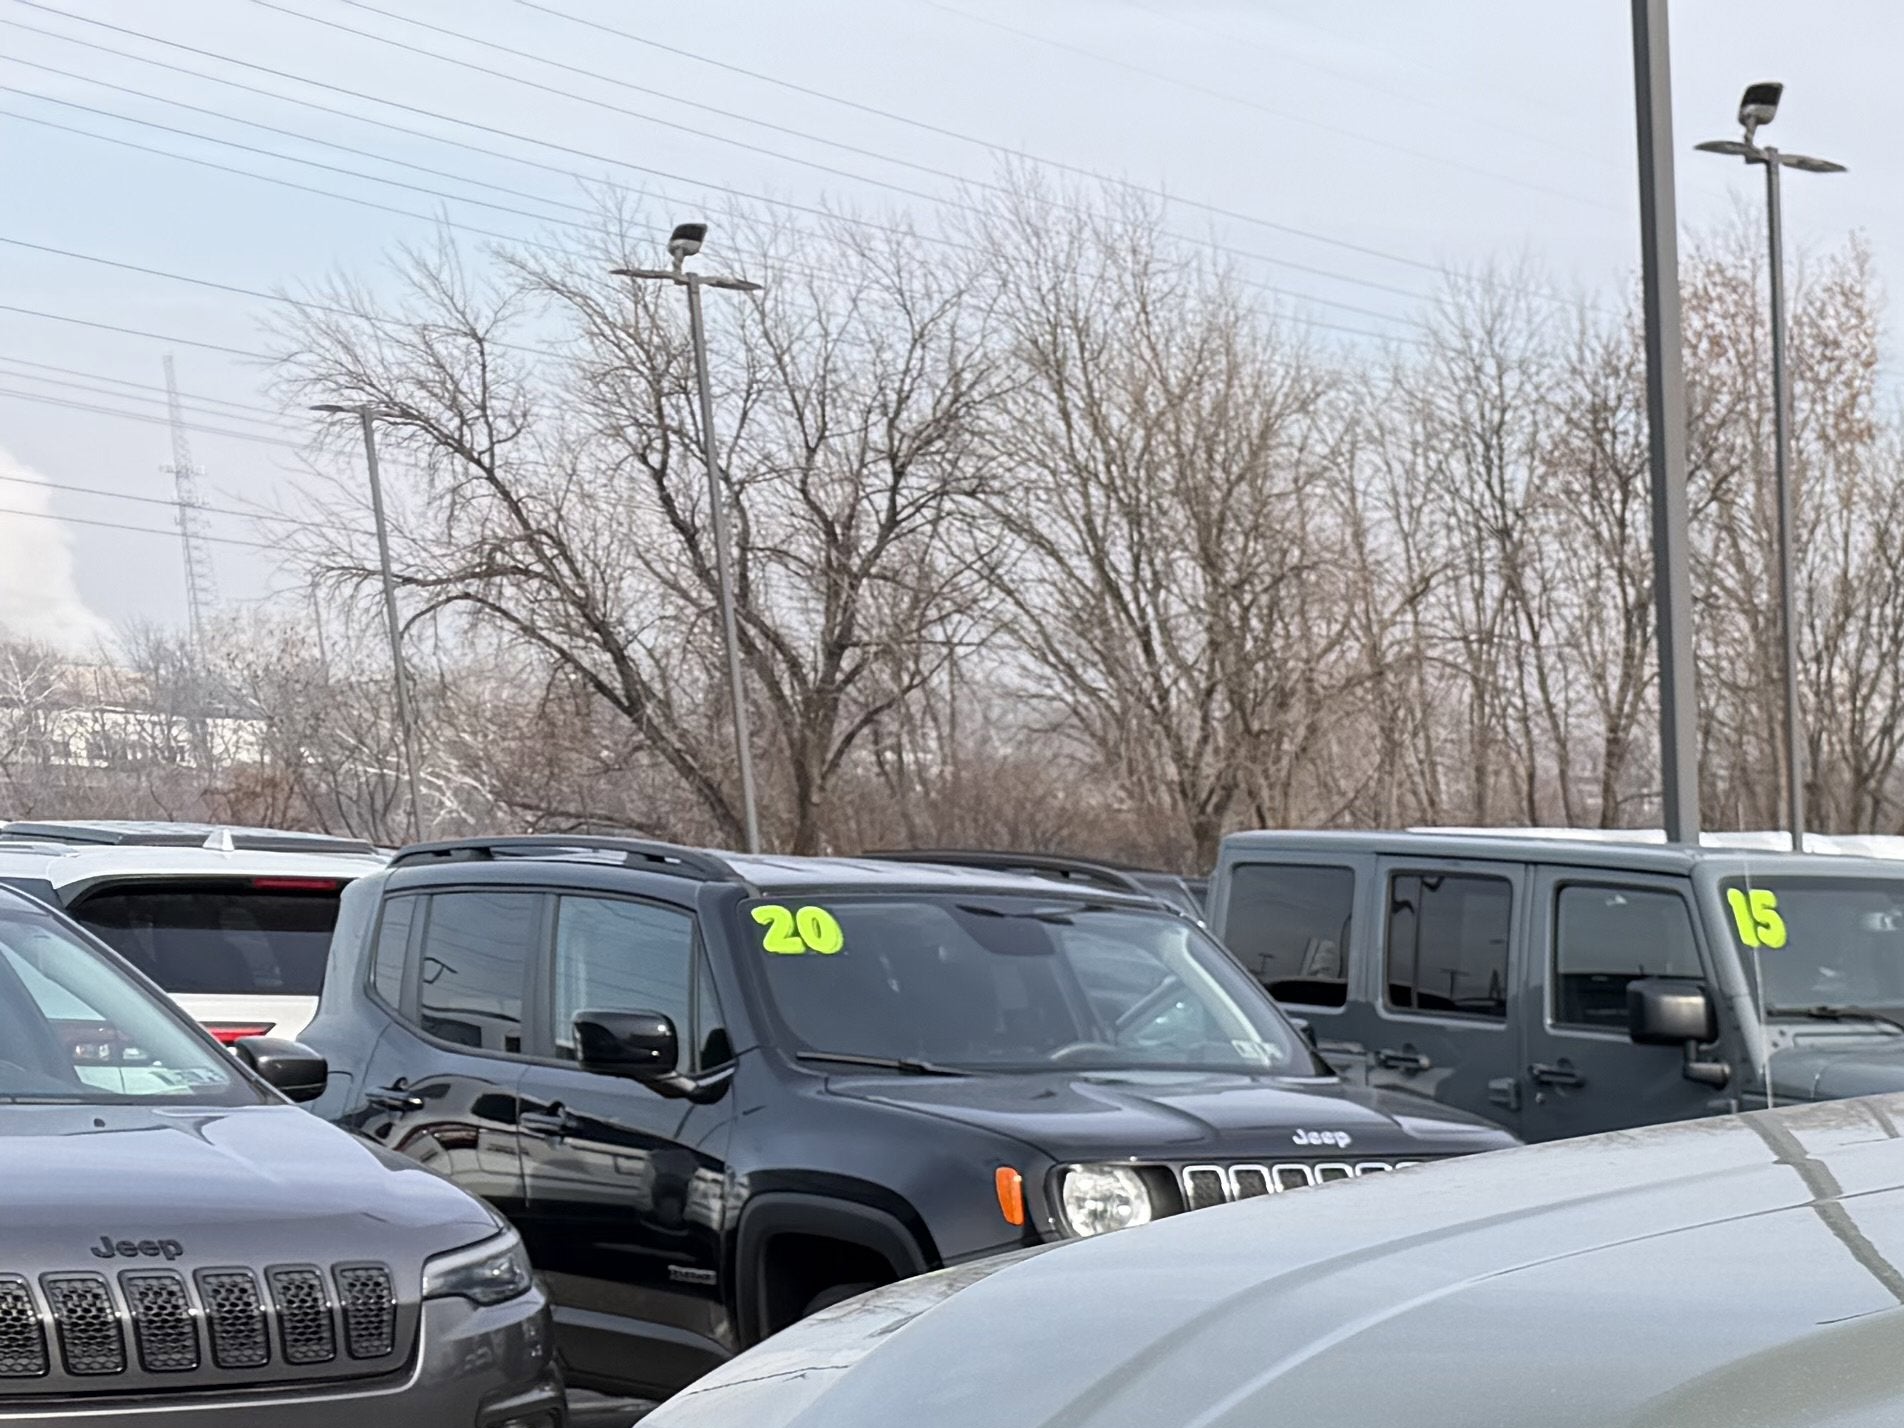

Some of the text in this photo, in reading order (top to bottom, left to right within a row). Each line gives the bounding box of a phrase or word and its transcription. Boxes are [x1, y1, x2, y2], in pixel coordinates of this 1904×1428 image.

[750, 904, 844, 955] 20
[1726, 887, 1787, 949] 15
[1291, 1128, 1352, 1149] Jeep
[90, 1235, 184, 1261] Jeep
